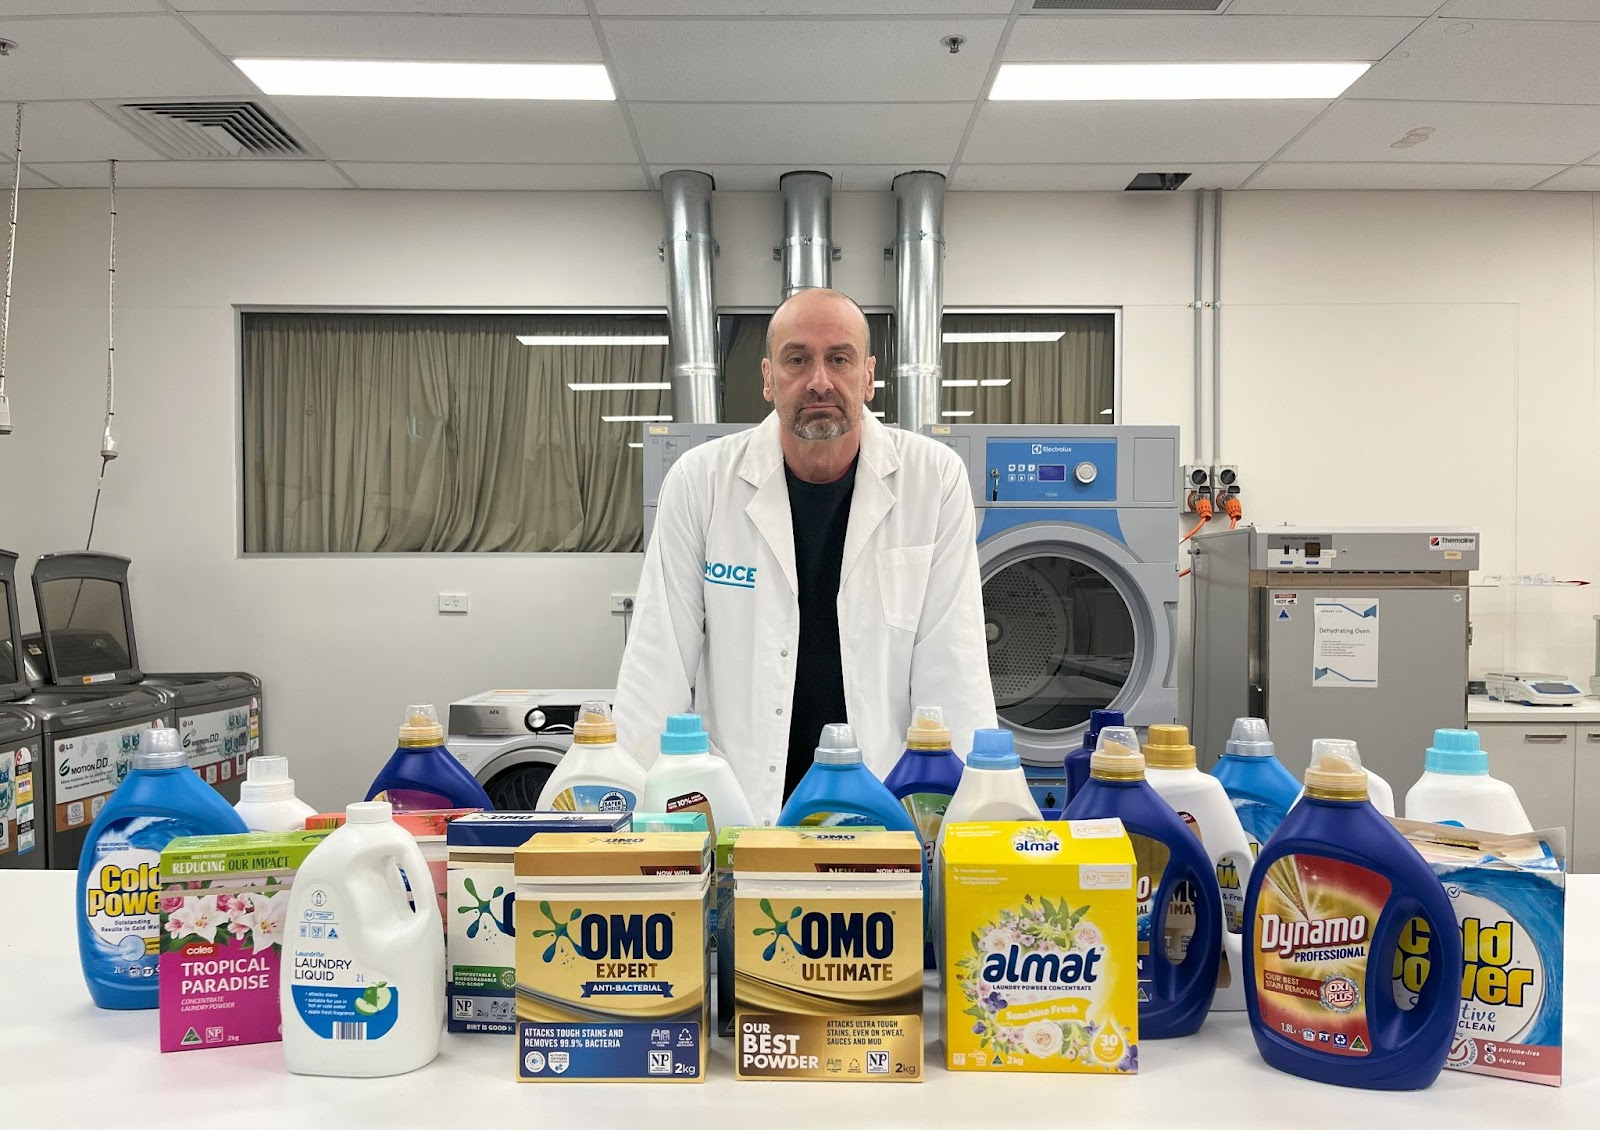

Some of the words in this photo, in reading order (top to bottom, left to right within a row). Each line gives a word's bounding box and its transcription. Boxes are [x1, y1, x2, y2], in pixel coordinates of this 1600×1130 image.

[705, 561, 757, 583] HOICE
[1319, 627, 1354, 635] Dehydrating
[71, 763, 96, 775] MOTION
[95, 757, 109, 769] DD
[1015, 840, 1060, 851] almat
[172, 860, 225, 874] REDUCING
[228, 858, 249, 870] OUR
[252, 856, 290, 869] IMPACT
[88, 889, 160, 917] Powe
[581, 913, 673, 960] OMO
[801, 912, 893, 959] OMO
[1260, 914, 1368, 958] Dynamo
[186, 946, 214, 955] coles
[1294, 946, 1366, 962] PROFESSIONAL
[181, 957, 271, 977] TROPICAL
[294, 957, 353, 970] LAUNDRY
[983, 944, 1102, 983] almat
[294, 969, 335, 981] LIQUID
[596, 963, 658, 978] EXPERT
[802, 963, 893, 981] ULTIMATE
[181, 974, 270, 995] PARADISE
[1265, 973, 1281, 983] OUR
[1282, 976, 1299, 986] BEST
[592, 984, 662, 992] ANTI-BACTERIAL
[1265, 980, 1284, 991] STAIN
[1284, 984, 1319, 997] REMOVAL
[1329, 982, 1350, 992] OXI
[181, 996, 225, 1005] CONCENTRATE
[1329, 991, 1354, 1003] PLUS
[181, 1003, 208, 1012] LAUNDRY
[208, 1002, 235, 1010] POWDER
[457, 1000, 472, 1012] NP
[477, 1009, 489, 1018] 2kg
[1005, 1008, 1049, 1021] Sunshine
[1051, 1005, 1078, 1015] Fresh
[466, 1020, 481, 1030] DIRT
[482, 1020, 488, 1030] IS
[488, 1021, 507, 1031] GOOD
[743, 1022, 771, 1034] OUR
[826, 1020, 854, 1028] ATTACKS
[1281, 1022, 1295, 1034] 1.8L
[1458, 1020, 1496, 1032] CLEAN
[207, 1028, 222, 1038] NP
[524, 1028, 555, 1038] ATTACKS
[556, 1028, 580, 1038] TOUGH
[581, 1028, 607, 1038] STAINS
[608, 1028, 624, 1038] AND
[826, 1029, 851, 1037] STAINS,
[881, 1029, 905, 1038] SWEAT,
[524, 1038, 558, 1048] REMOVES
[559, 1038, 583, 1048] 99.9%
[585, 1038, 620, 1048] BACTERIA
[743, 1034, 800, 1055] BEST
[1100, 1034, 1119, 1046] 30
[1498, 1047, 1540, 1057] perfume-free
[651, 1054, 669, 1067] NP
[674, 1062, 696, 1076] 2kg
[743, 1055, 820, 1069] POWDER
[869, 1053, 887, 1066] NP
[895, 1062, 916, 1074] 2kg
[1006, 1055, 1024, 1065] 2kg
[1498, 1058, 1526, 1066] dye-free
